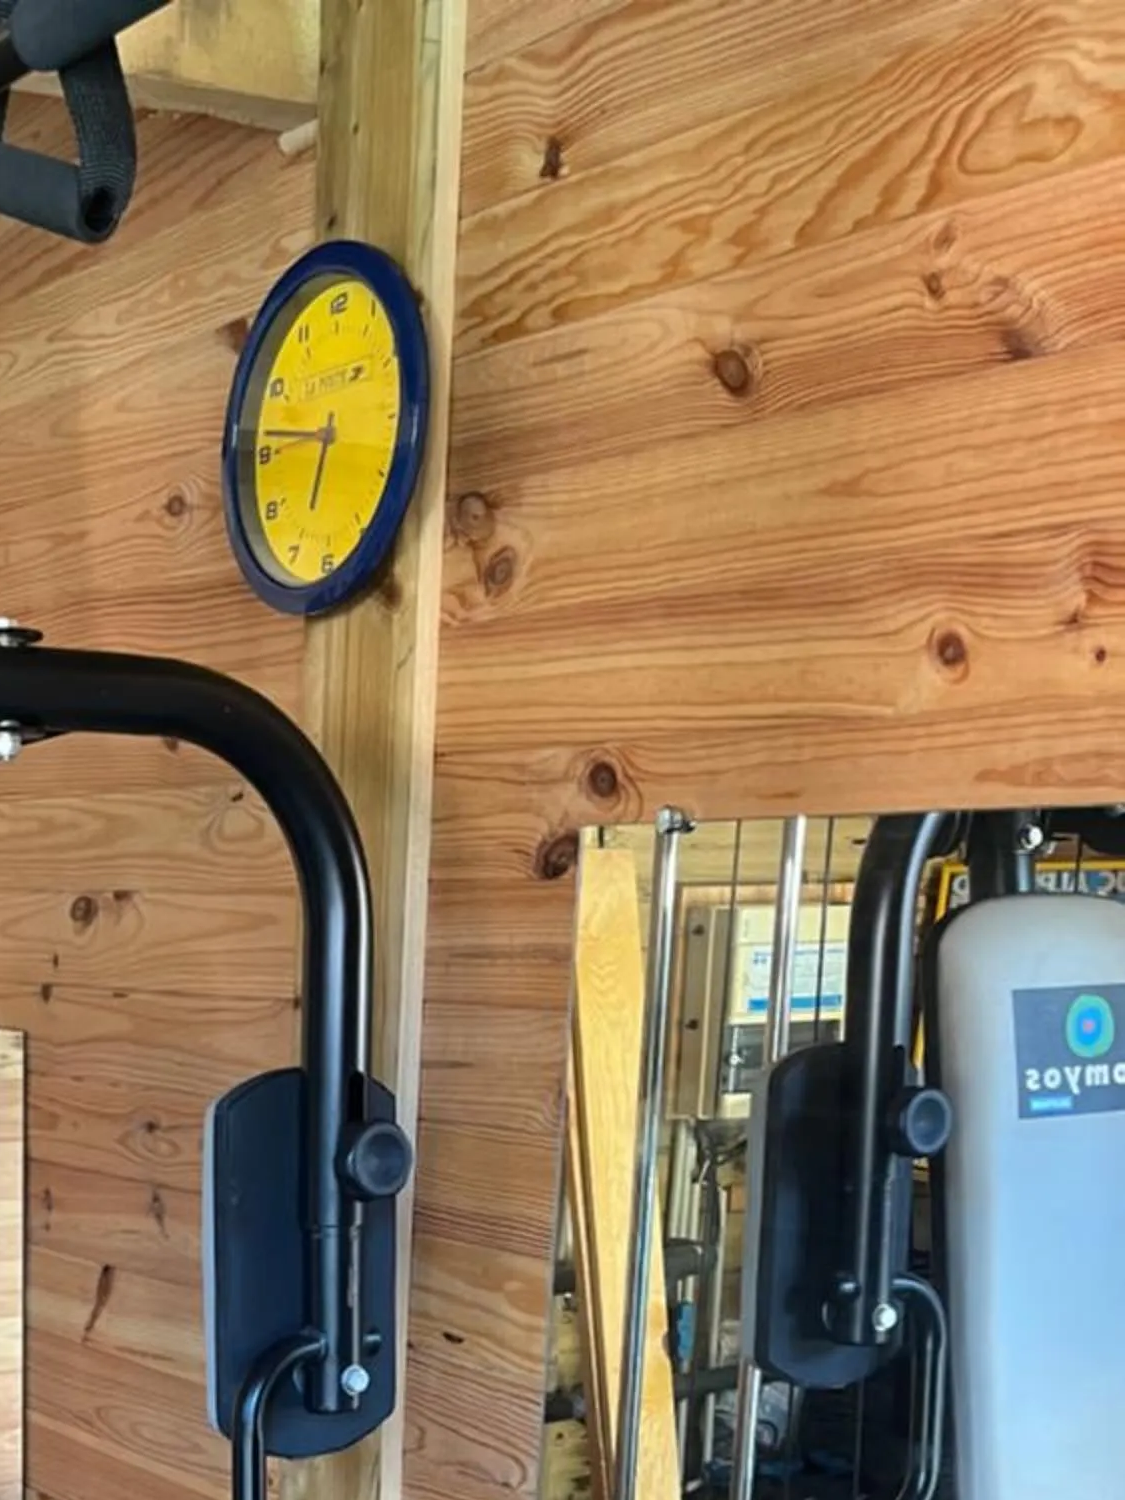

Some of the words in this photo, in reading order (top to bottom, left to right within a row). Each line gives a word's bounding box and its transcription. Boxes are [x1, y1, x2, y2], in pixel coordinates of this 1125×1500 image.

[331, 292, 348, 314] 12
[298, 324, 309, 343] 11
[259, 445, 271, 464] 9
[266, 501, 278, 520] 8
[287, 544, 299, 565] 7
